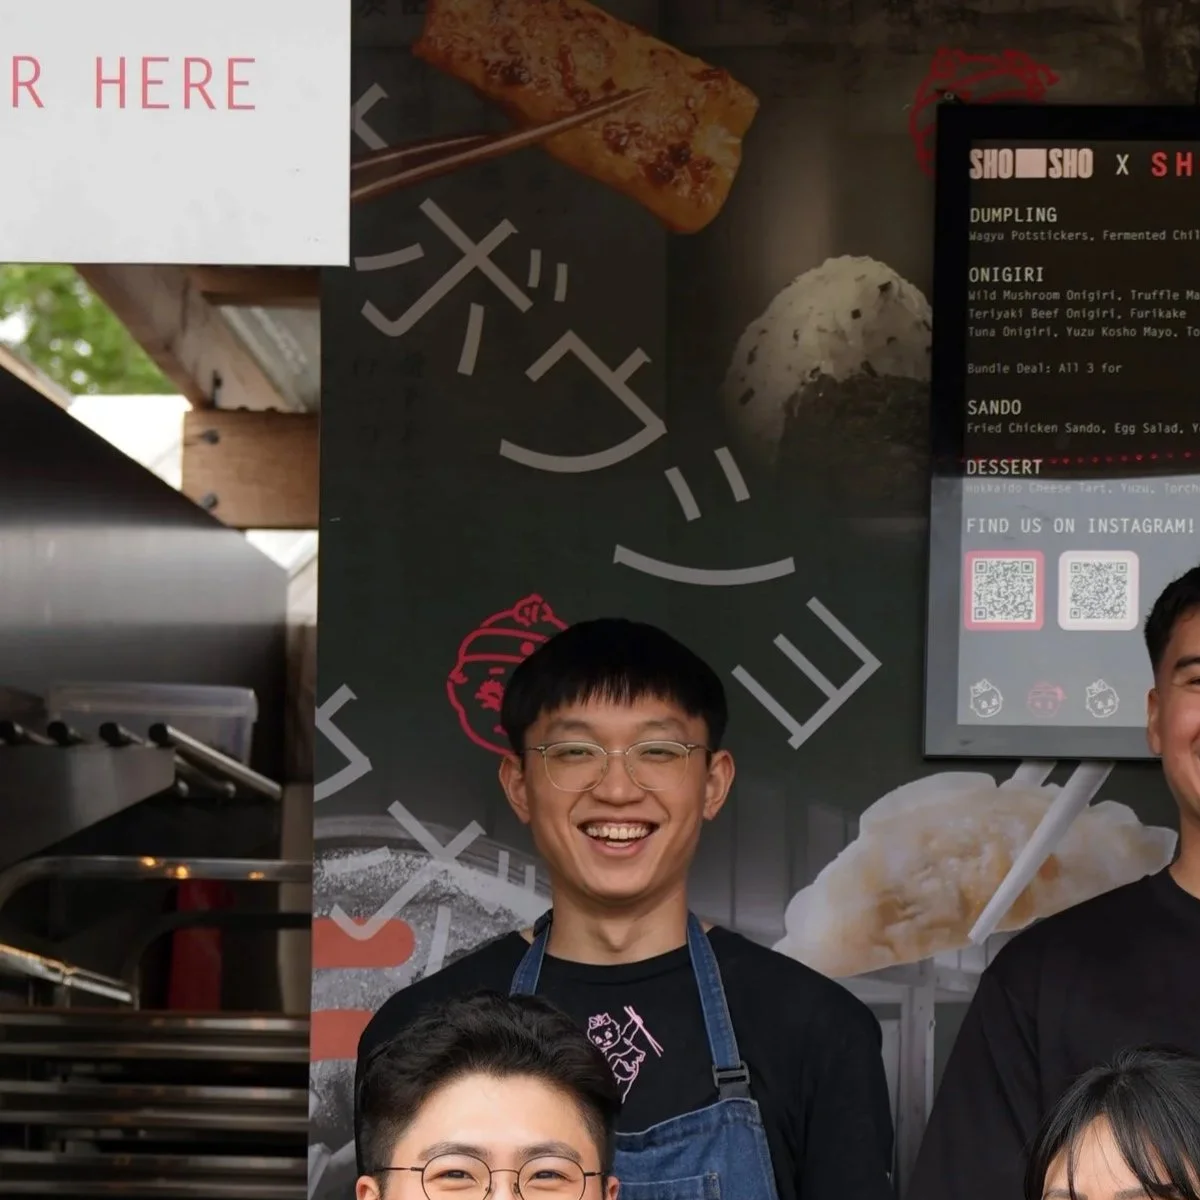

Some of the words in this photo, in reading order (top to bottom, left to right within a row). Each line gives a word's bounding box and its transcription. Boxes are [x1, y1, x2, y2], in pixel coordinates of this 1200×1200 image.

[96, 57, 256, 110] HERE
[969, 148, 1014, 179] SHO
[1048, 148, 1093, 178] SHO
[970, 207, 1057, 223] DUMPLING
[968, 230, 1004, 243] Wagyu
[1103, 229, 1166, 242] Fermented
[969, 267, 1043, 283] ONIGIRI
[968, 289, 996, 301] Wild
[1003, 289, 1060, 301] Mushroom
[1131, 289, 1179, 301] Truffle
[968, 308, 1023, 321] Teriyaki
[1031, 308, 1059, 320] Beef
[1130, 308, 1187, 320] Furikake
[967, 326, 996, 338] Tuna
[1066, 326, 1095, 338] Yuzu
[1102, 326, 1137, 338] Kosho
[967, 363, 1010, 375] Bundle
[1017, 363, 1051, 375] Deal:
[1059, 362, 1079, 374] All
[1087, 362, 1095, 374] 3
[1102, 362, 1123, 374] for
[968, 400, 1022, 416] SANDO
[967, 422, 1002, 434] Fried
[1009, 422, 1058, 434] Chicken
[1114, 422, 1136, 436] Egg
[966, 459, 1043, 476] DESSERT
[967, 518, 1009, 534] FIND
[1021, 518, 1042, 534] US
[1054, 518, 1075, 534] ON
[1088, 518, 1195, 534] INSTAGRAM!
